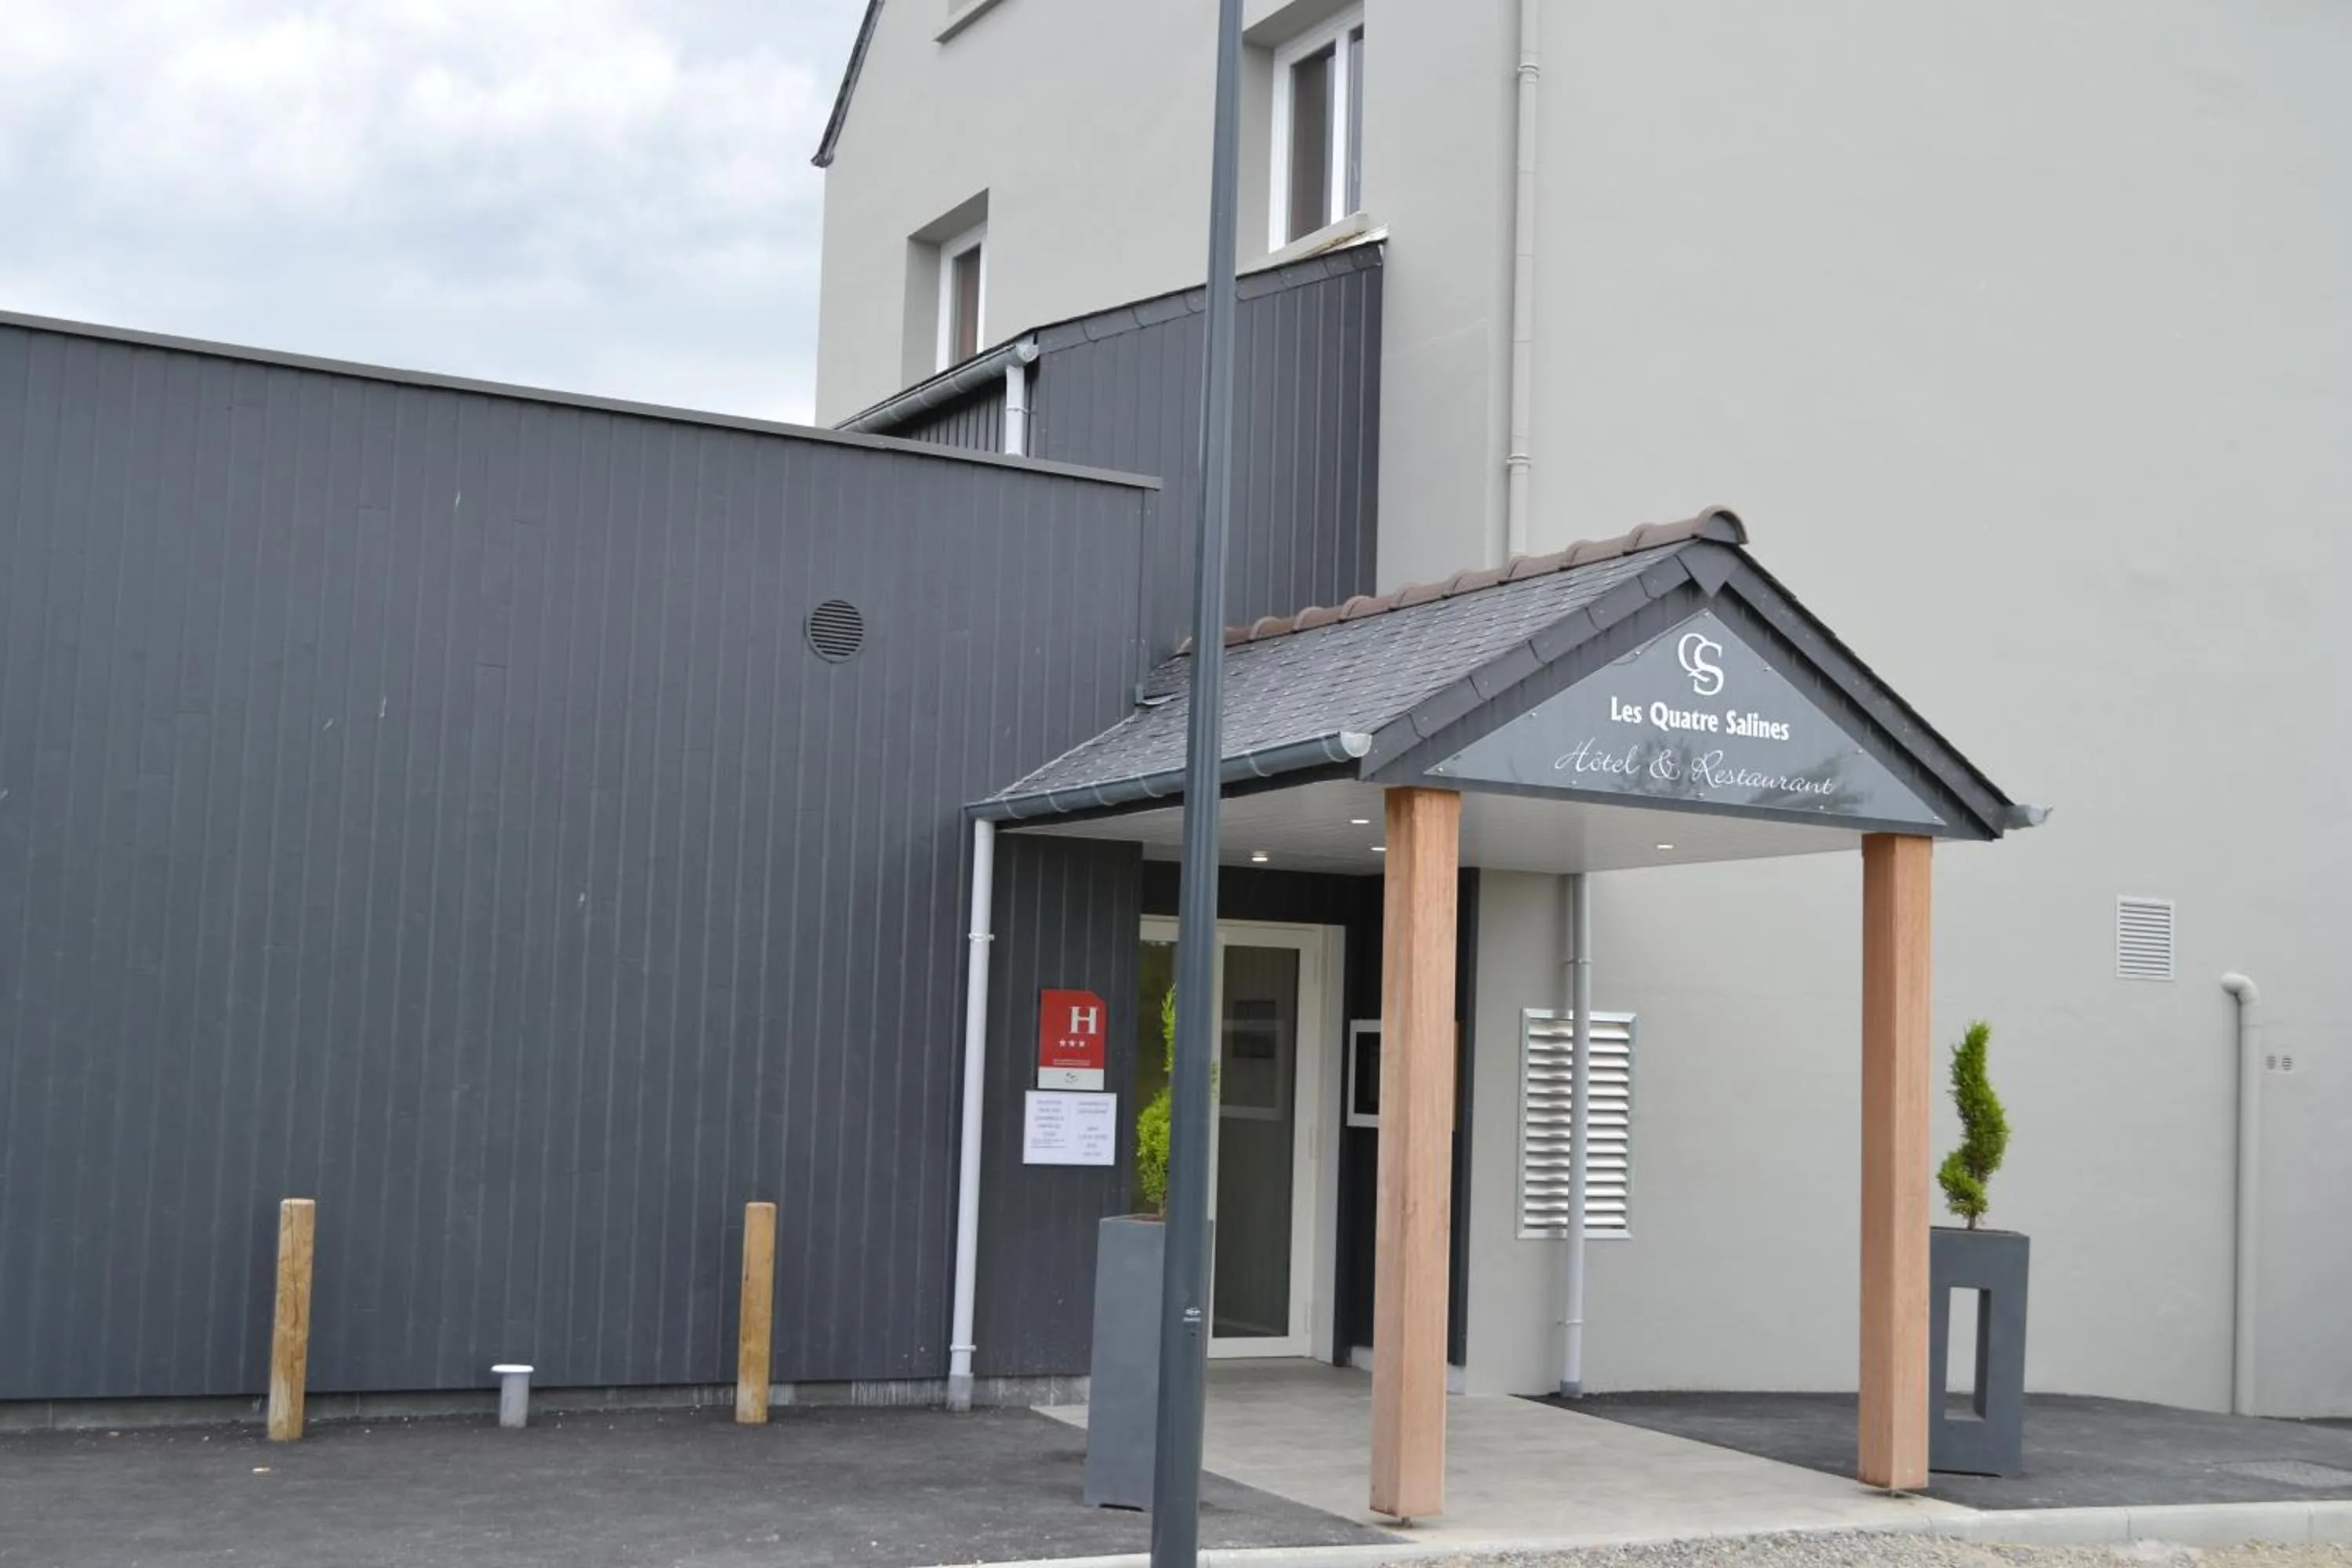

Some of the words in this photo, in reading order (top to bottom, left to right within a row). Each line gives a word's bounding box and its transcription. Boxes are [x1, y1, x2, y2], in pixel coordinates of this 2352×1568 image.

[1611, 696, 1642, 724] Les
[1650, 702, 1718, 732] Quatre
[1726, 711, 1789, 740] Salines
[1555, 738, 1641, 775] Hôtel
[1649, 749, 1680, 780] &
[1690, 750, 1833, 795] Restaurant
[1069, 1006, 1099, 1034] H
